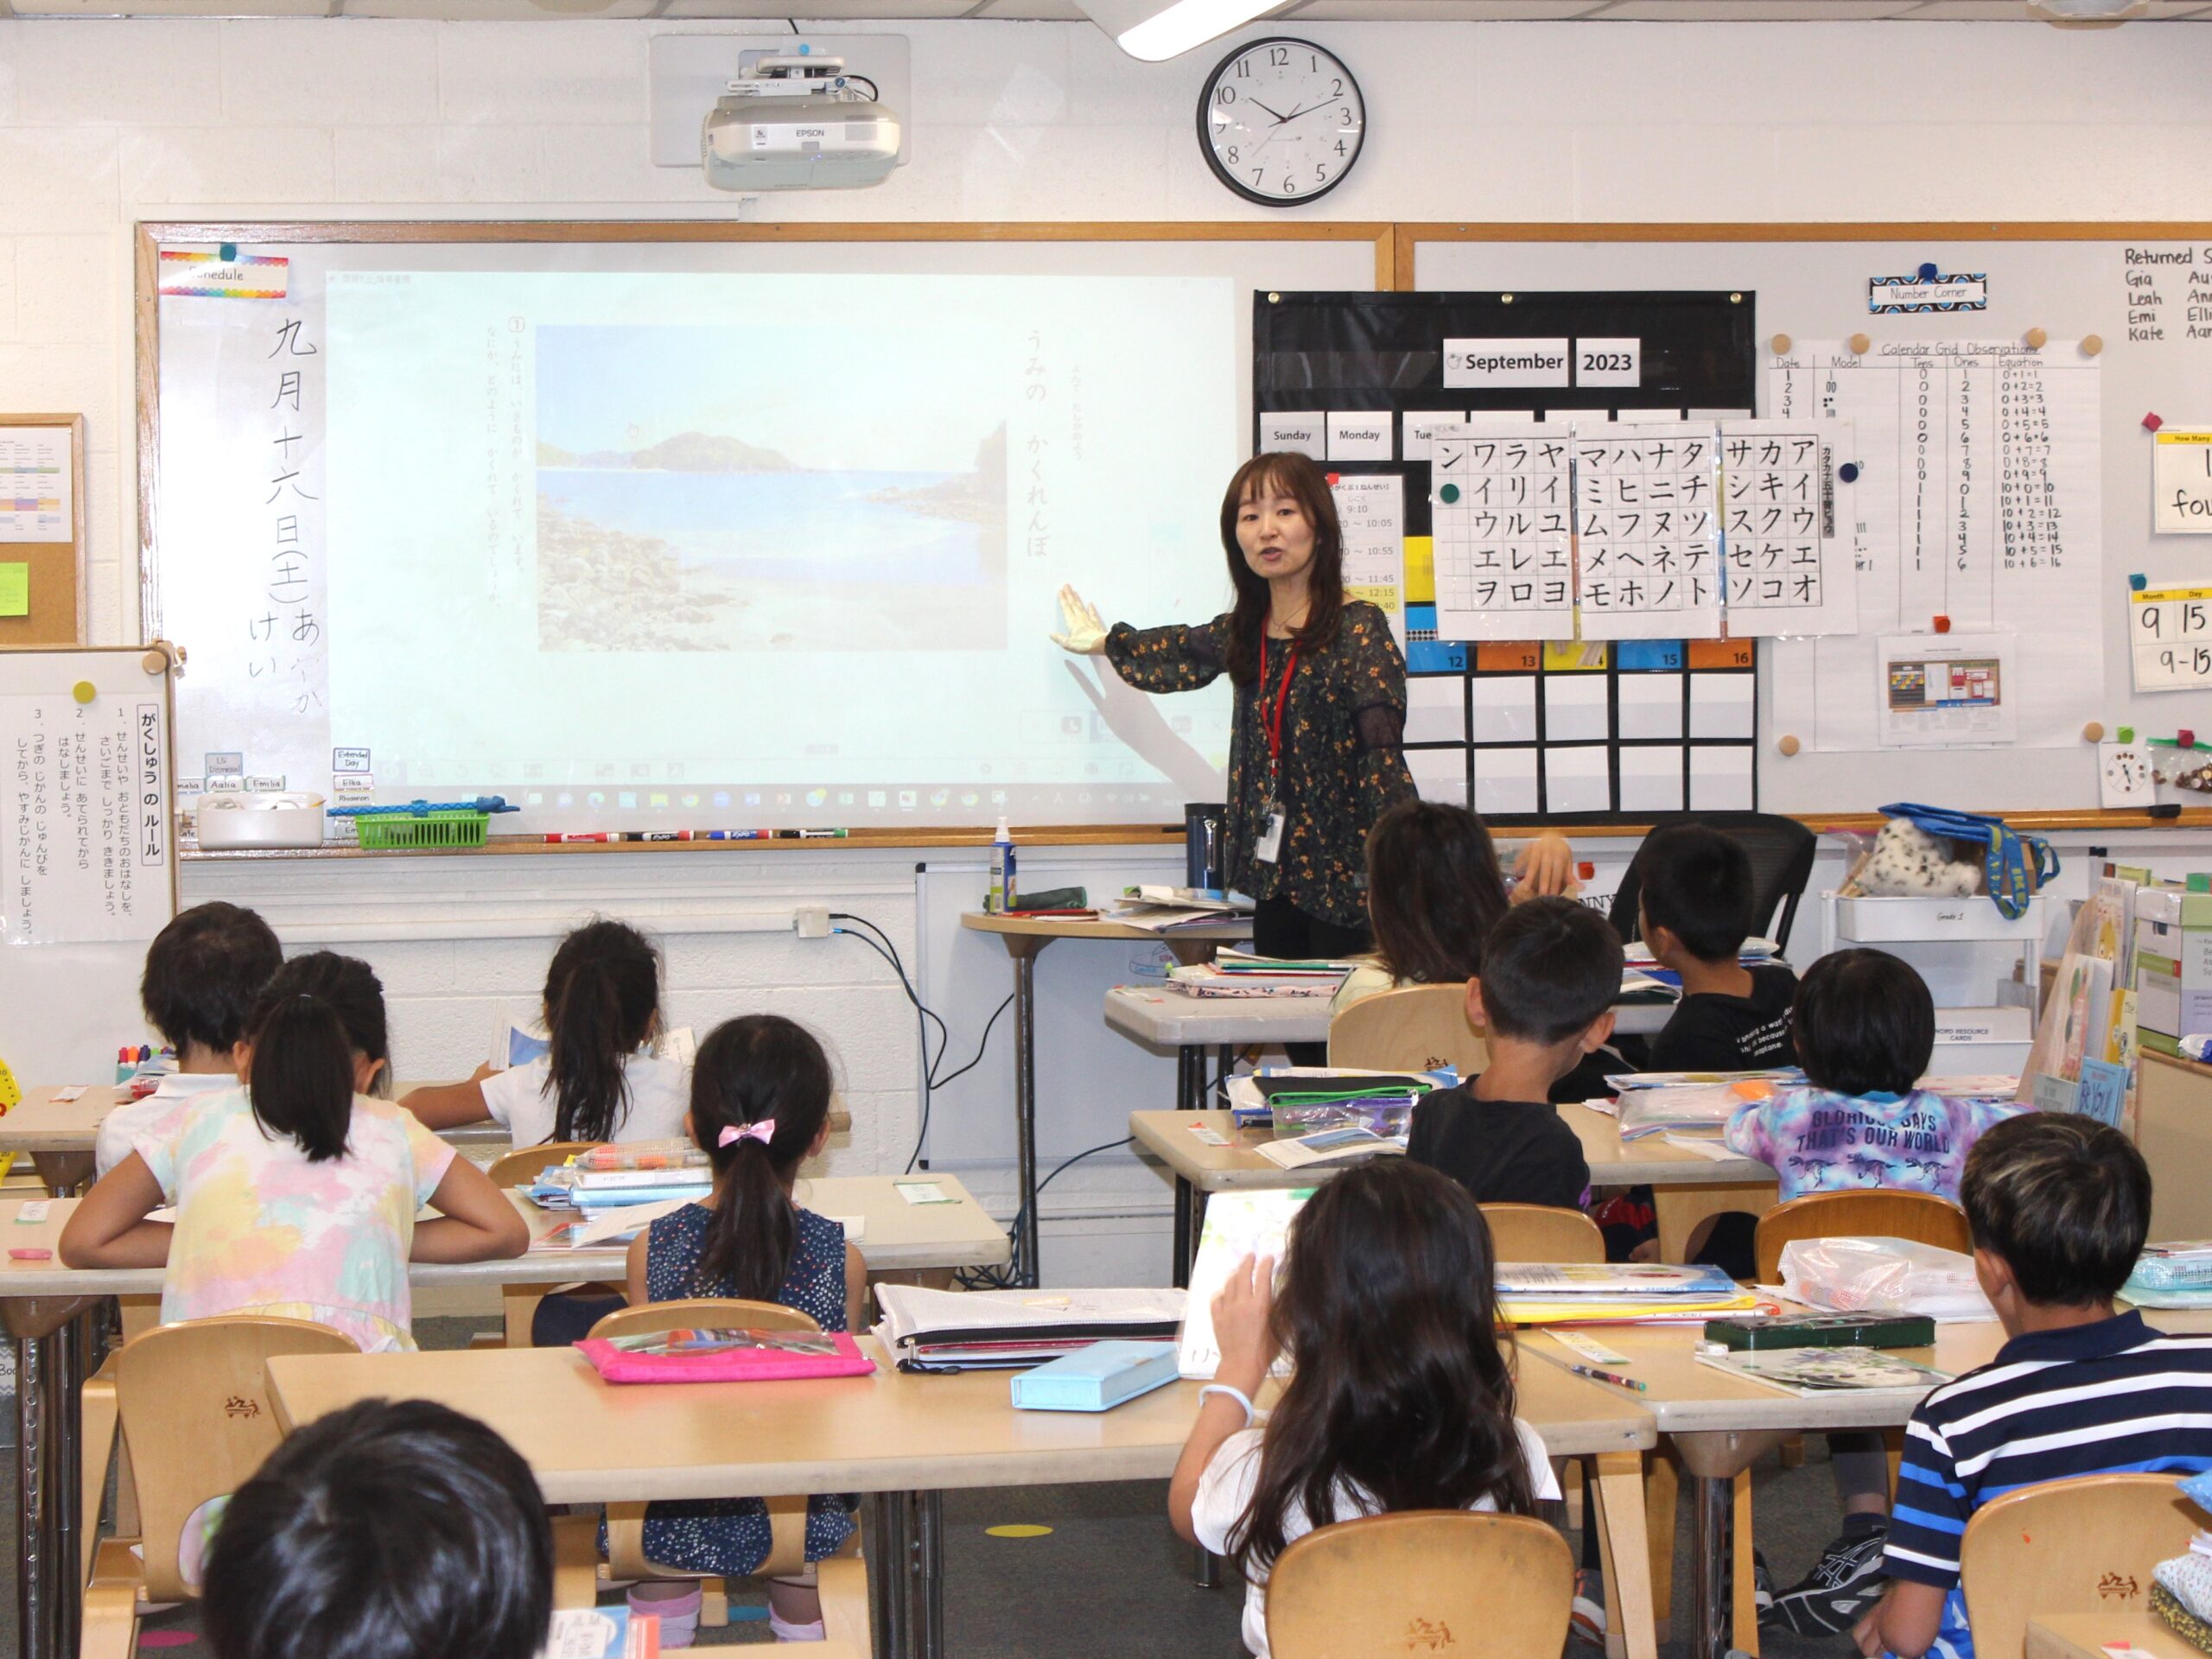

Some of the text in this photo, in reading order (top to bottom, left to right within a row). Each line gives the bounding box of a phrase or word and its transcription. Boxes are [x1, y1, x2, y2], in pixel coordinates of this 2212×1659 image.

[1270, 48, 1289, 66] 12
[1236, 60, 1250, 78] 11
[1312, 55, 1318, 73] 1
[1332, 79, 1344, 97] 2
[1217, 86, 1236, 105] 10
[1340, 107, 1352, 126] 3
[1334, 139, 1347, 156] 4
[1228, 146, 1239, 164] 8
[1252, 168, 1263, 187] 7
[1316, 163, 1326, 181] 5
[1284, 175, 1295, 194] 6
[2125, 247, 2192, 264] Returned
[2126, 270, 2152, 288] Gia
[1891, 286, 1967, 299] Number Corner
[2128, 290, 2162, 306] Leah
[2128, 308, 2156, 324] Emi
[2129, 326, 2164, 341] Kate
[1881, 343, 1929, 356] Calendar
[1936, 342, 1958, 355] Grid
[1025, 330, 1046, 401] うみの
[1465, 353, 1632, 372] September 2023
[1777, 357, 1800, 368] Date
[1831, 355, 1860, 368] Model
[1912, 357, 1934, 369] Tens
[1954, 357, 1979, 367] Ones
[1998, 357, 2044, 370] Equation
[1785, 370, 1791, 381] 1
[1919, 369, 1927, 379] 0
[1784, 383, 1792, 394] 2
[1919, 381, 1928, 391] 0
[1961, 381, 1970, 391] 2
[1783, 396, 1792, 407] 3
[1918, 395, 1927, 405] 0
[1961, 395, 1968, 405] 3
[1782, 408, 1790, 419] 4
[1919, 408, 1927, 417] 0
[1961, 407, 1968, 416] 4
[1918, 420, 1926, 430] 0
[1961, 419, 1969, 429] 5
[1274, 430, 1311, 442] Sunday
[1339, 430, 1380, 442] Monday
[1917, 433, 1928, 442] 0
[1961, 433, 1969, 443] 6
[1917, 446, 1925, 454] 0
[1963, 445, 1969, 455] 7
[1917, 458, 1925, 469] 0
[1963, 458, 1971, 470] 8
[1918, 470, 1926, 480] 0
[1962, 470, 1970, 481] 9
[1960, 484, 1969, 495] 0
[1960, 509, 1969, 518] 2
[1958, 522, 1967, 531] 3
[1958, 533, 1967, 546] 4
[1959, 545, 1967, 555] 5
[1957, 558, 1967, 571] 6
[2141, 607, 2160, 639] 9
[2183, 604, 2206, 633] 15
[1449, 657, 1463, 668] 12
[1522, 656, 1535, 667] 13
[1662, 654, 1677, 665] 15
[1733, 653, 1749, 664] 16
[346, 759, 359, 769] Day
[58, 736, 72, 817] はなしましょう。
[141, 713, 160, 857] がくしゅう の ルール
[34, 771, 47, 816] じかんの
[76, 792, 89, 869] あてられてから
[99, 736, 116, 917] さいごまで しっかり ききましょう。
[35, 820, 48, 875] じゅんびを
[20, 875, 33, 935] しましょう。
[1796, 1127, 1950, 1154] THAT'S OUR WORLD
